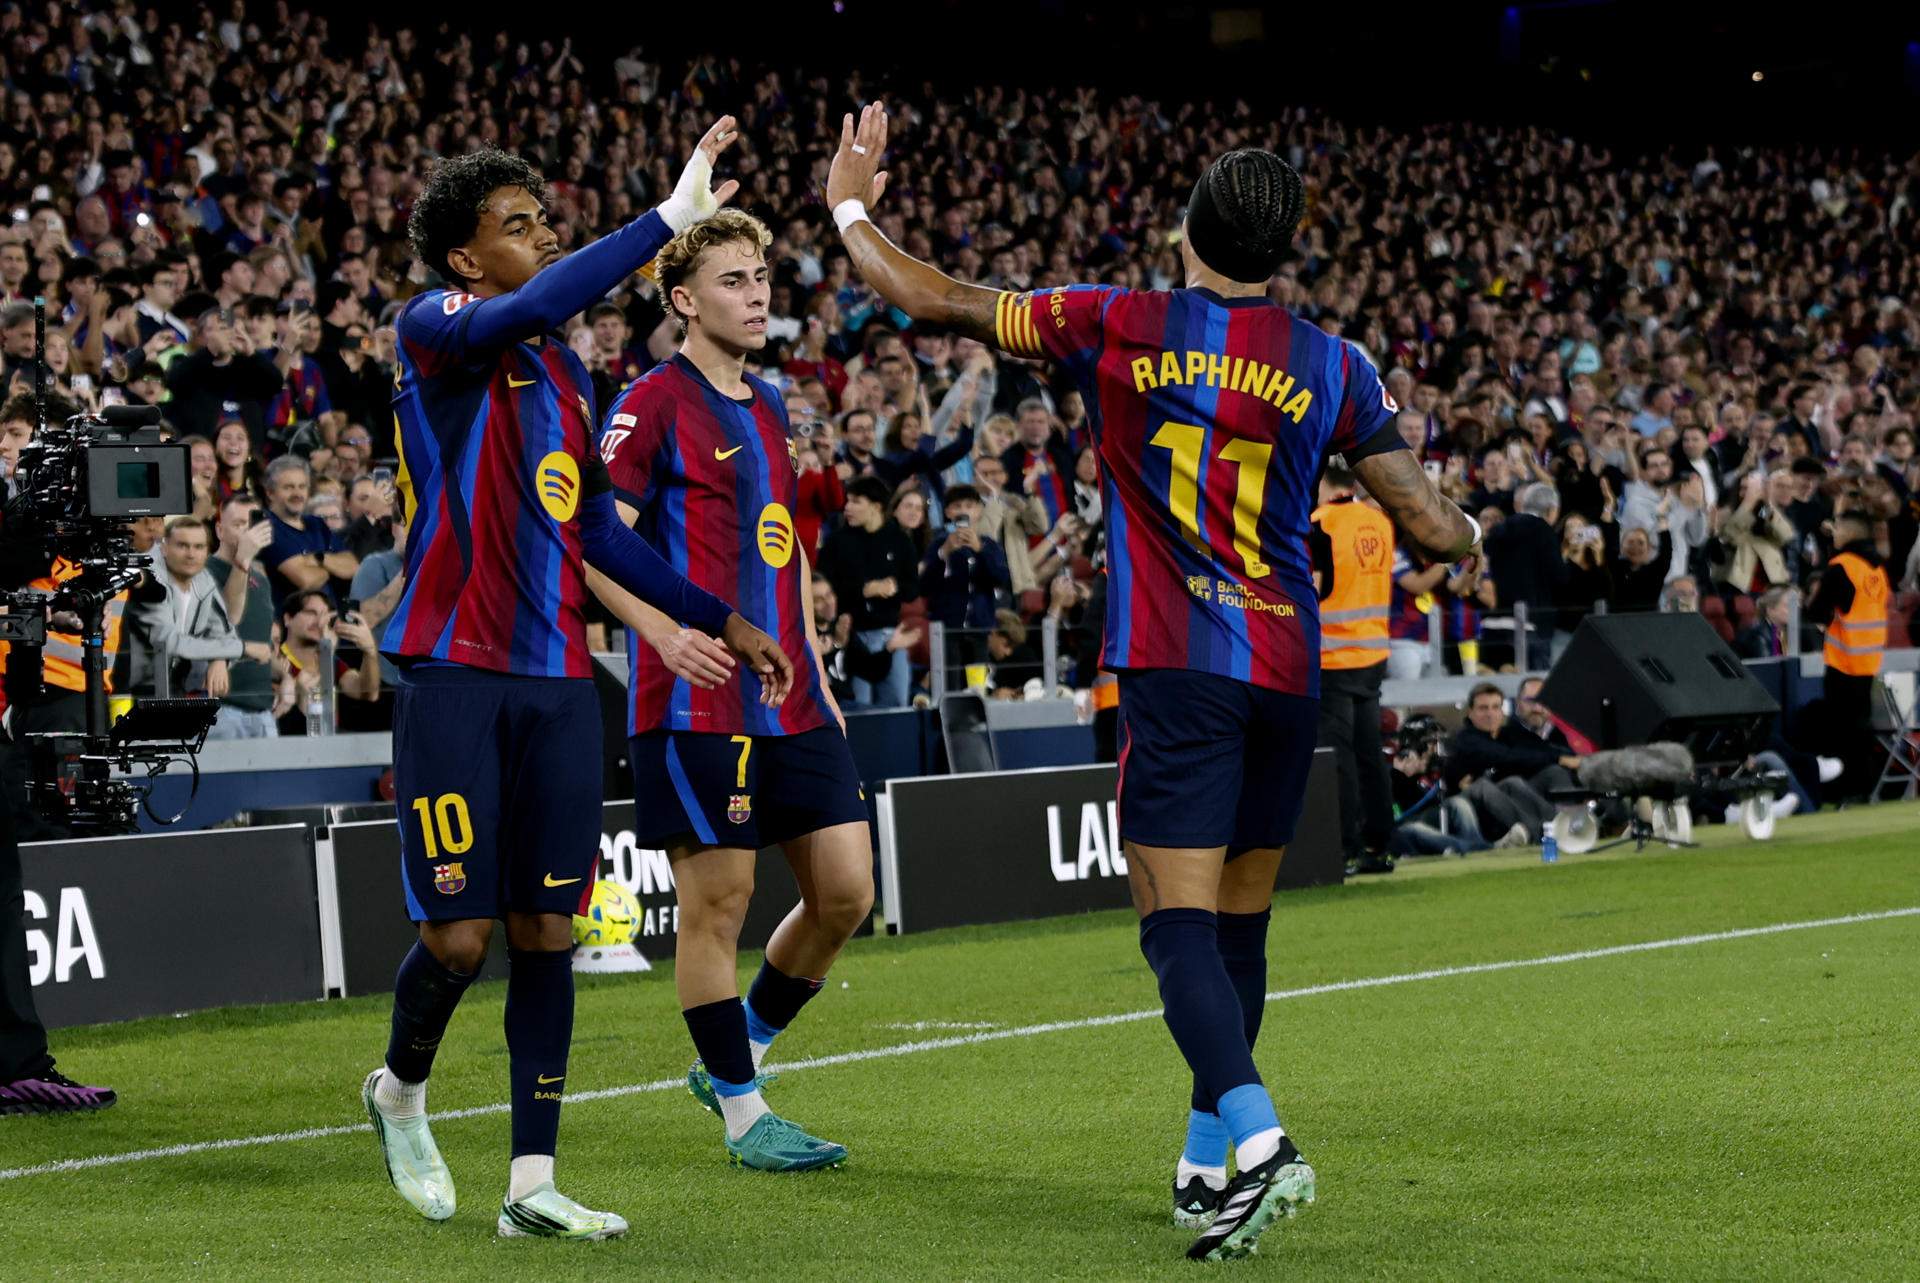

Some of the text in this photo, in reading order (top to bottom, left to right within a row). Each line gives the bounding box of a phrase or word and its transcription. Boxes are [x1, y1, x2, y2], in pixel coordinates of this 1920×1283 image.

[1050, 293, 1066, 329] dea
[1131, 351, 1313, 424] RAPHINHA
[1150, 421, 1272, 578] 11
[730, 735, 752, 787] 7
[412, 793, 474, 858] 10
[596, 830, 676, 895] CON
